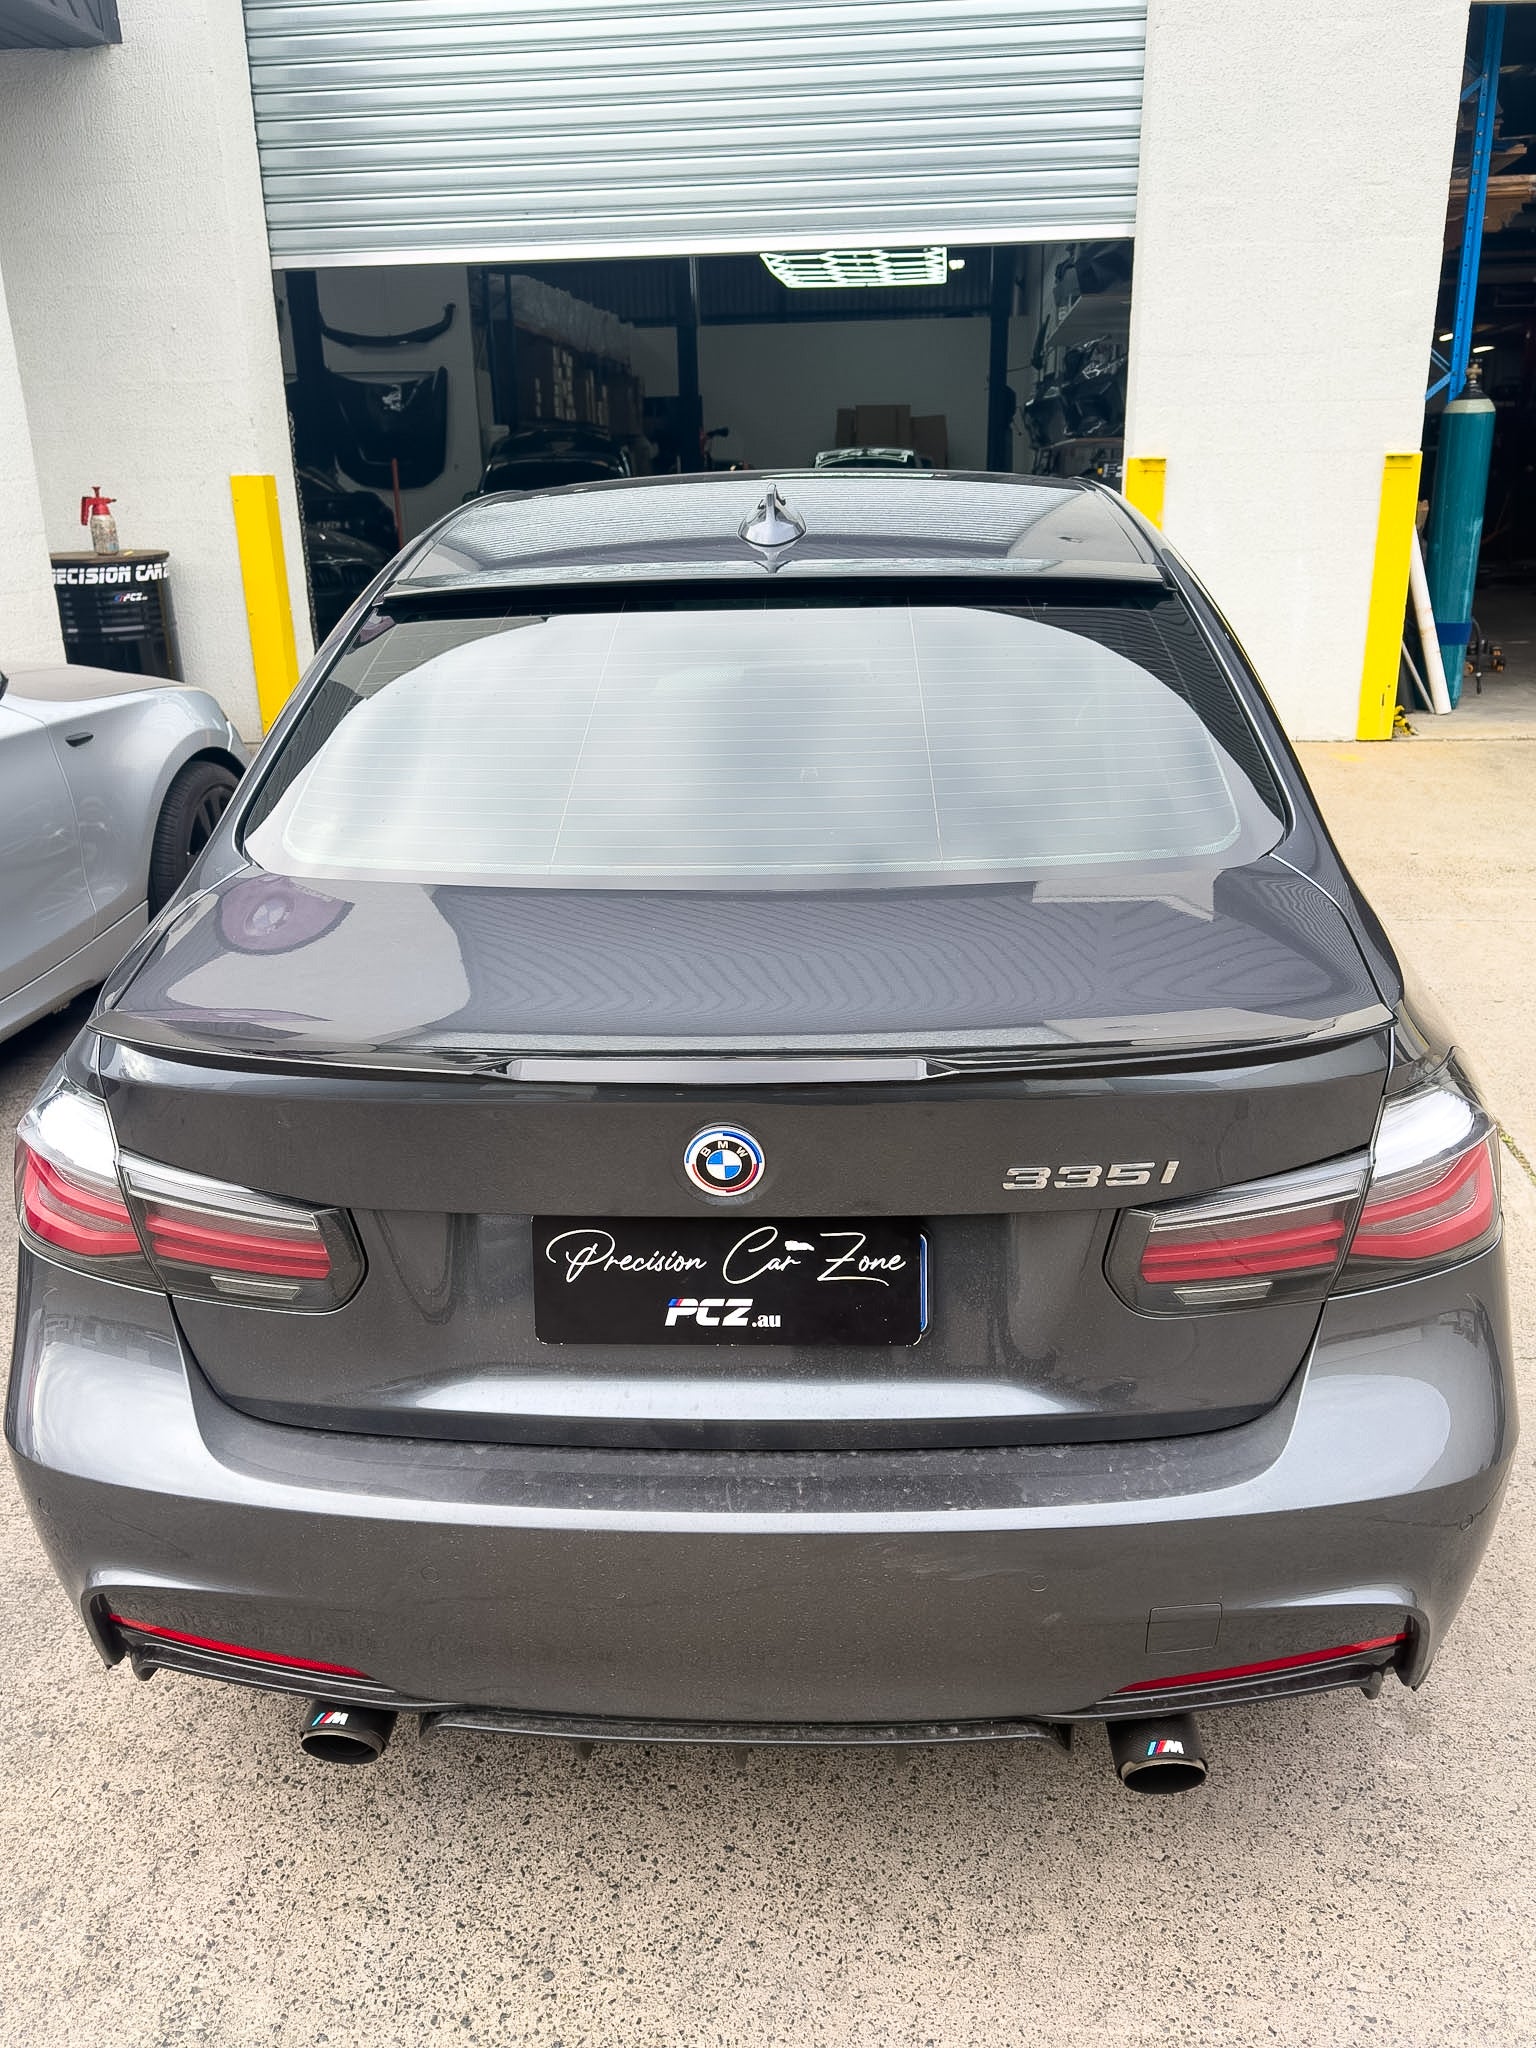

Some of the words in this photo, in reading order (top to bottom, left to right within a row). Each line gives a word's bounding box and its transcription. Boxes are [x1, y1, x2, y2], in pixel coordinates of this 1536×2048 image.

[700, 1140, 748, 1158] BMW
[546, 1229, 707, 1283] Precision
[722, 1226, 801, 1284] Car
[816, 1231, 906, 1286] Zone
